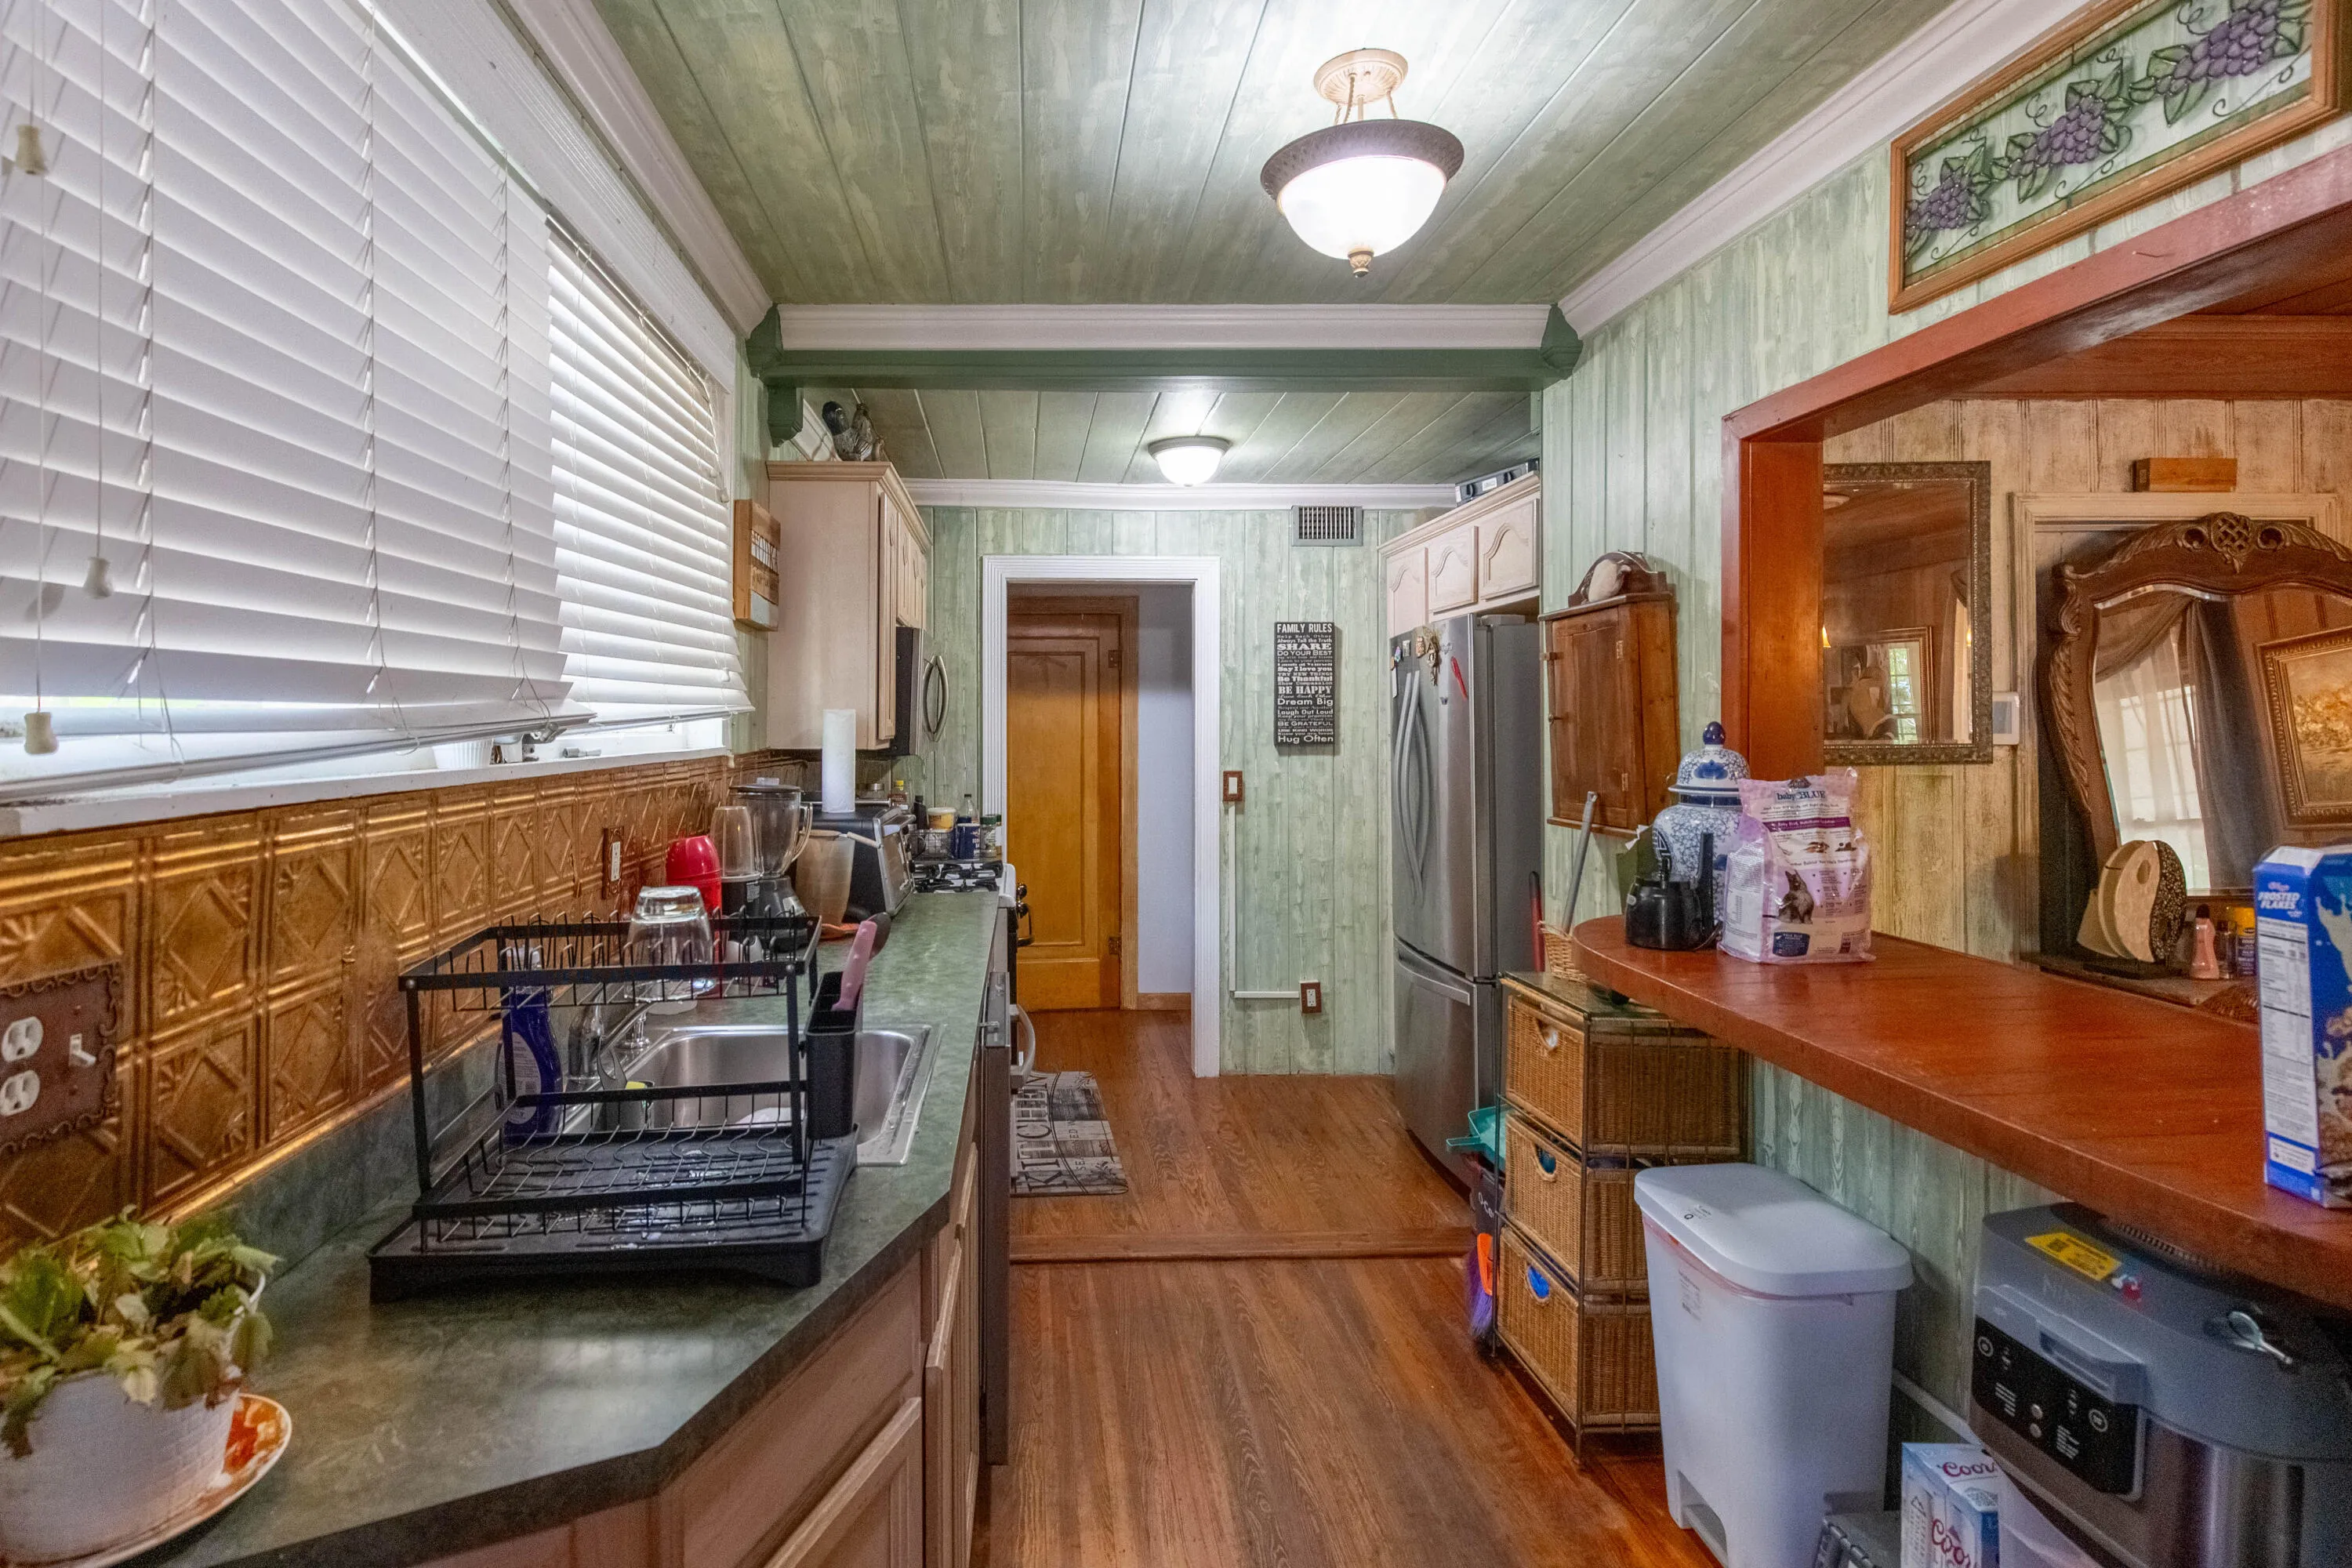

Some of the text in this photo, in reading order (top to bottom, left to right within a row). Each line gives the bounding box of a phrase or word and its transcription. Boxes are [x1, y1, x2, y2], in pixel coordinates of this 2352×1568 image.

[1277, 624, 1332, 633] FAMILY RULES
[1278, 686, 1332, 694] BE HAPPY
[1798, 790, 1826, 800] BLUE
[2258, 891, 2300, 901] FROSTED
[2260, 900, 2296, 909] FLAKES
